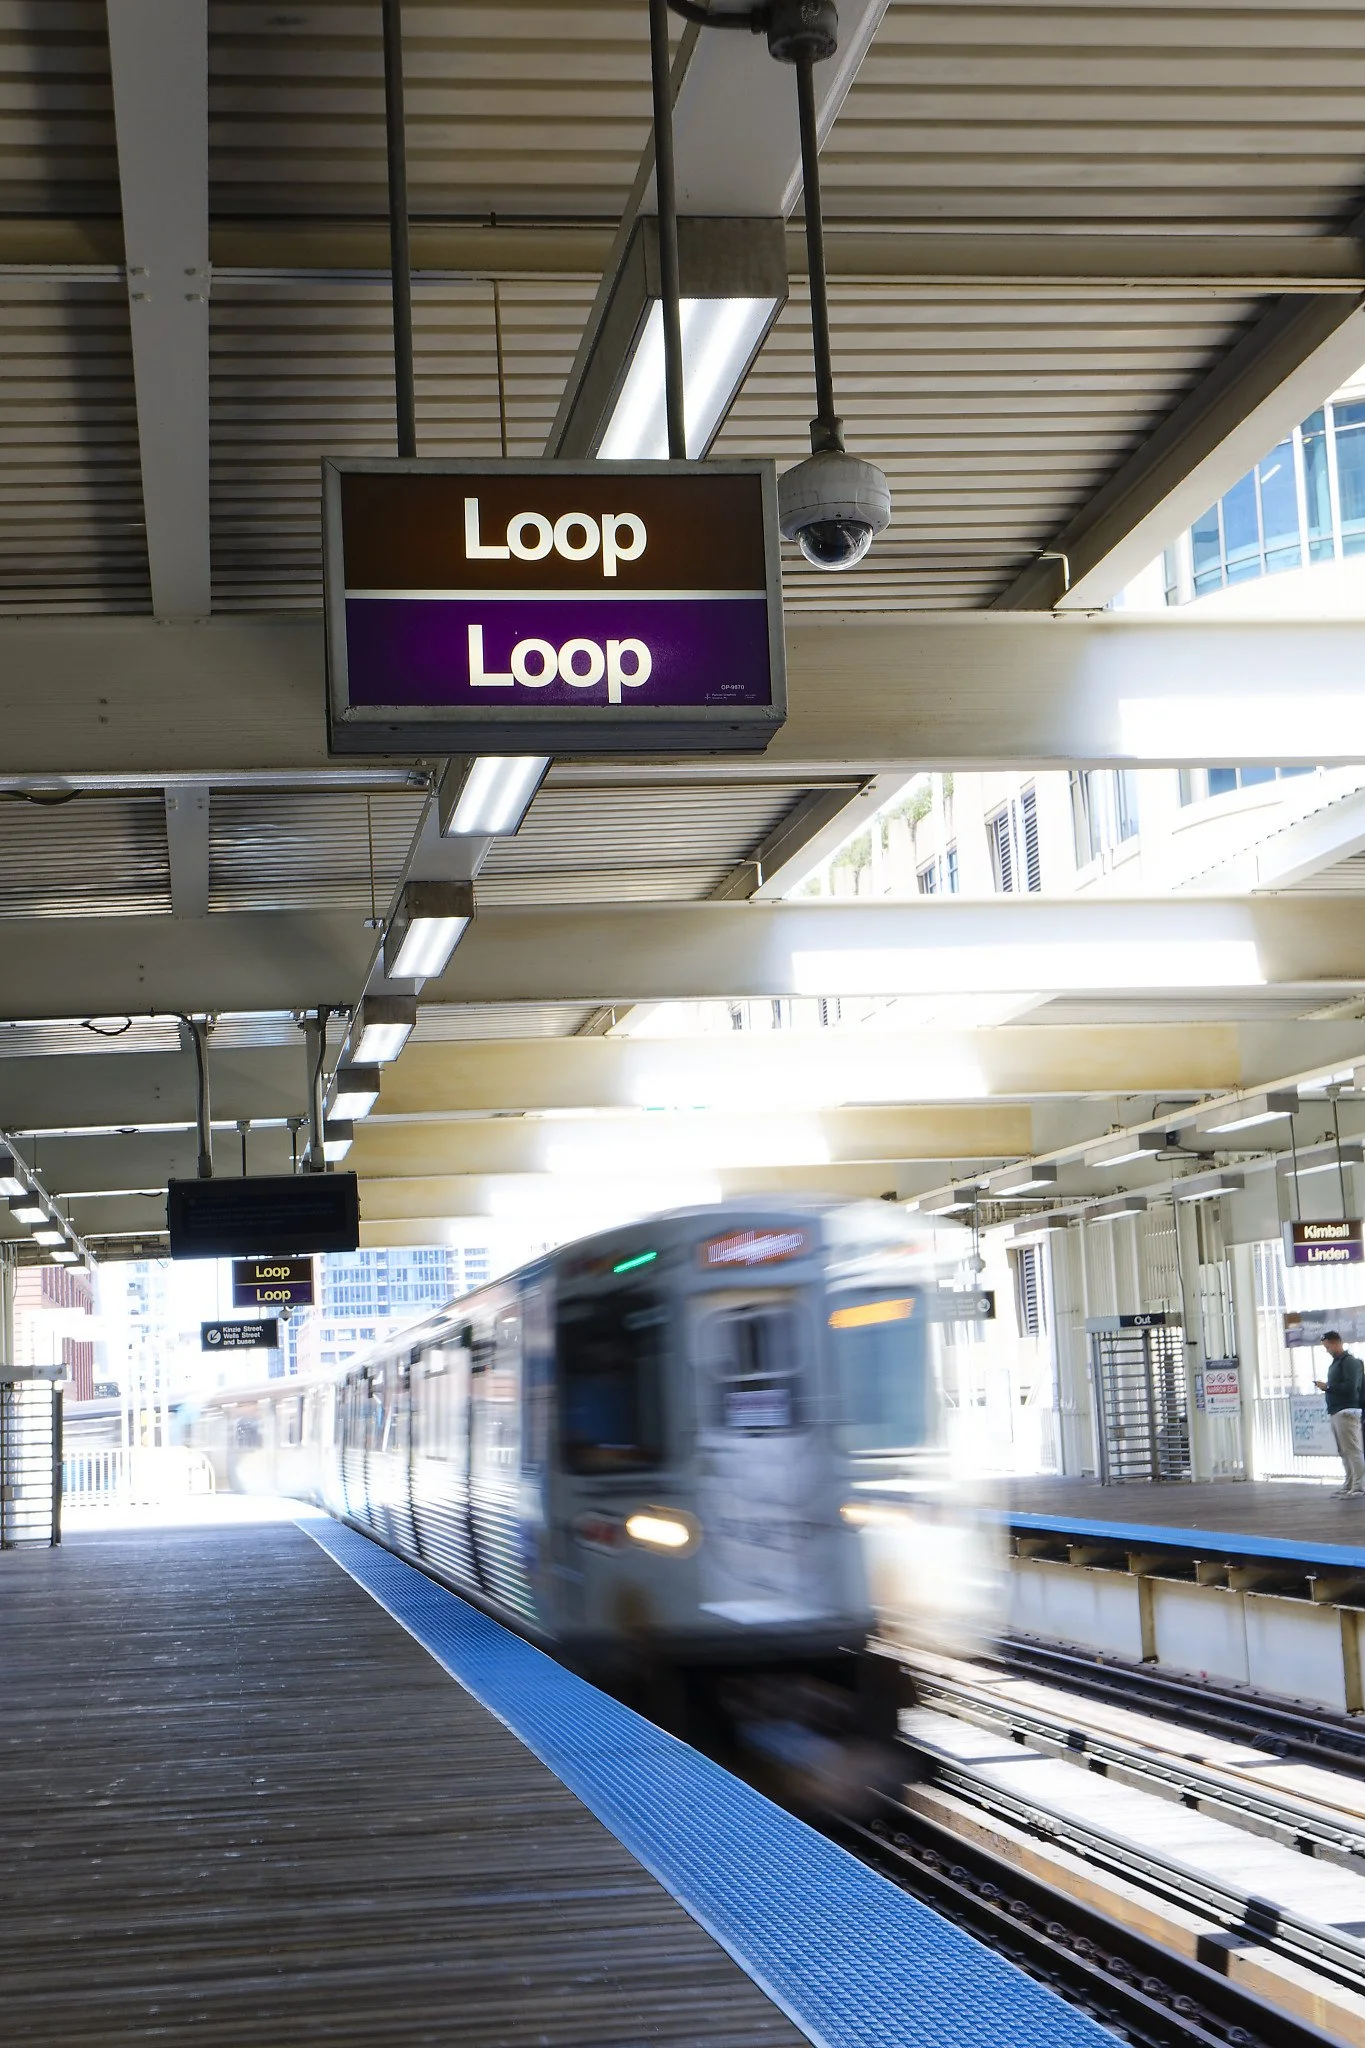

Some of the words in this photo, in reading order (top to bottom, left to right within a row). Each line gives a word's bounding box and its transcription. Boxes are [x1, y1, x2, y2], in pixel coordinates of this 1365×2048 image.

[464, 498, 647, 577] Loop
[468, 624, 652, 703] Loop
[1304, 1223, 1350, 1239] Kimball
[1307, 1247, 1350, 1261] Linden
[255, 1265, 290, 1279] Loop
[256, 1288, 291, 1303] Loop
[1133, 1315, 1151, 1325] Out
